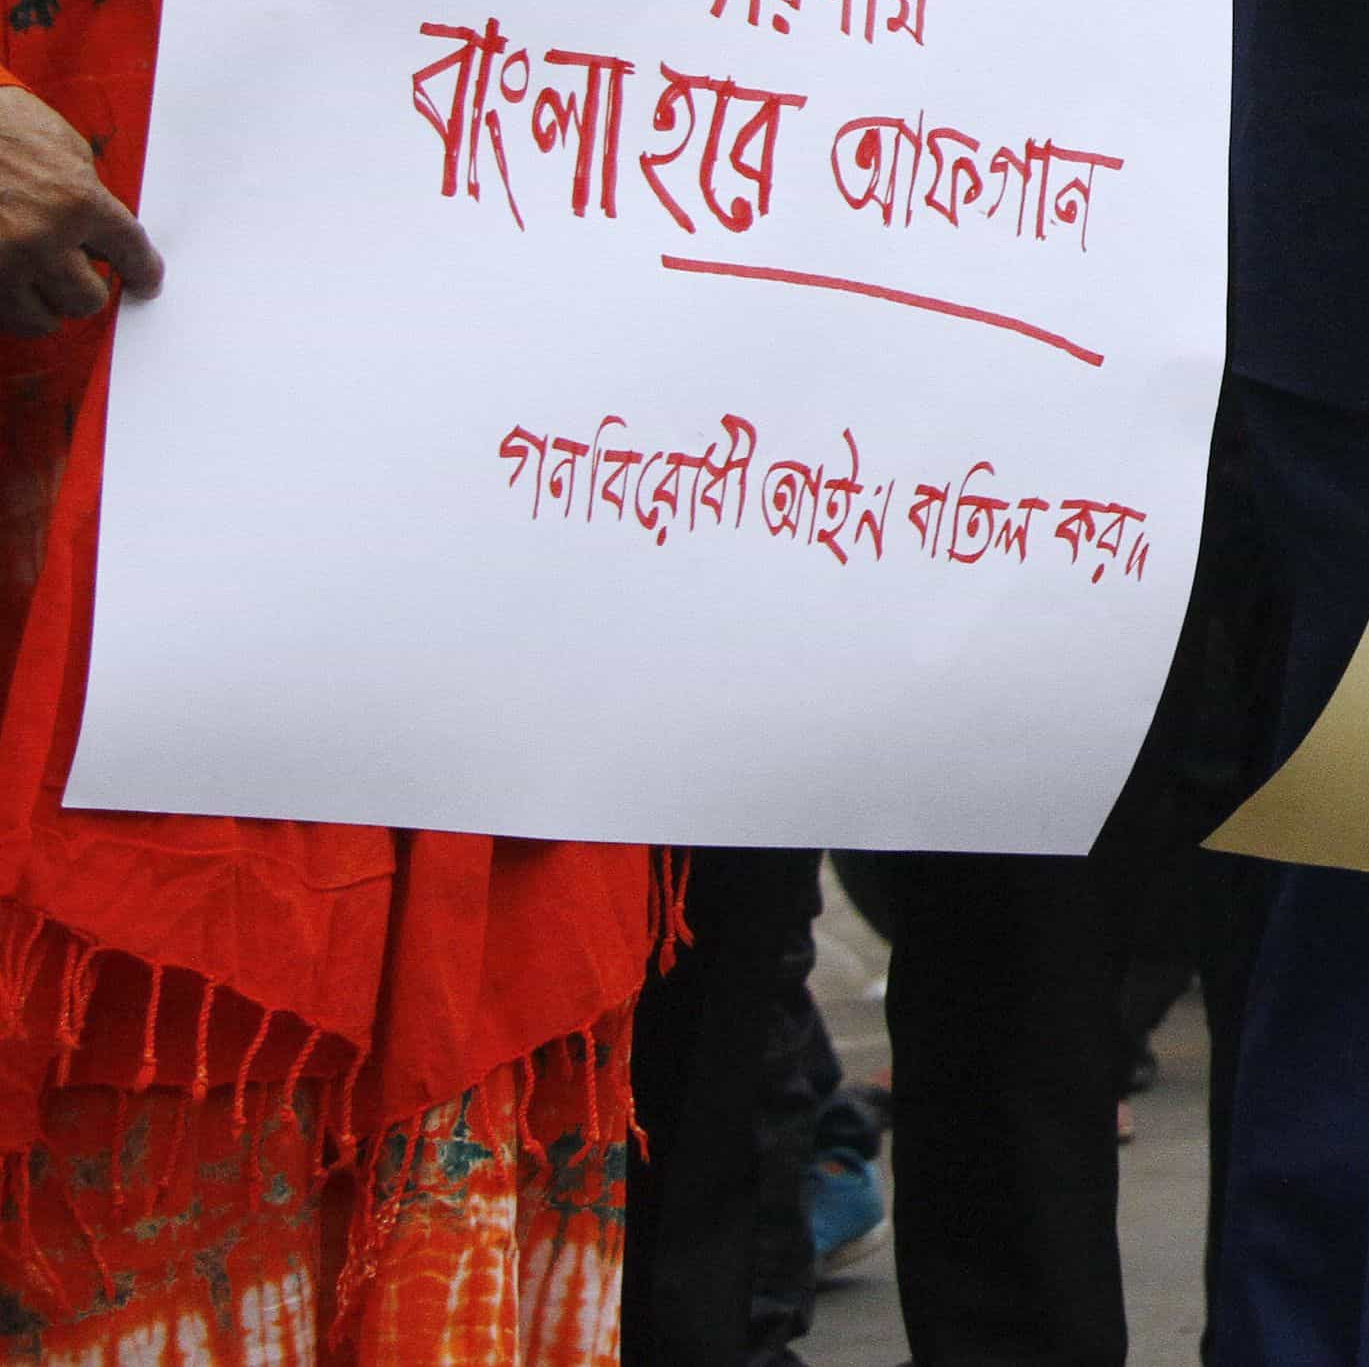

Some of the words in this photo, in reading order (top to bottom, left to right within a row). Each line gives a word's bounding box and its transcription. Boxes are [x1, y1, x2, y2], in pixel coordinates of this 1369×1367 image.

[412, 17, 636, 232] বাংলা
[638, 61, 808, 235] হবে
[830, 109, 1125, 252] আফগান
[761, 428, 895, 566] আইন
[907, 461, 1051, 564] বাতিল
